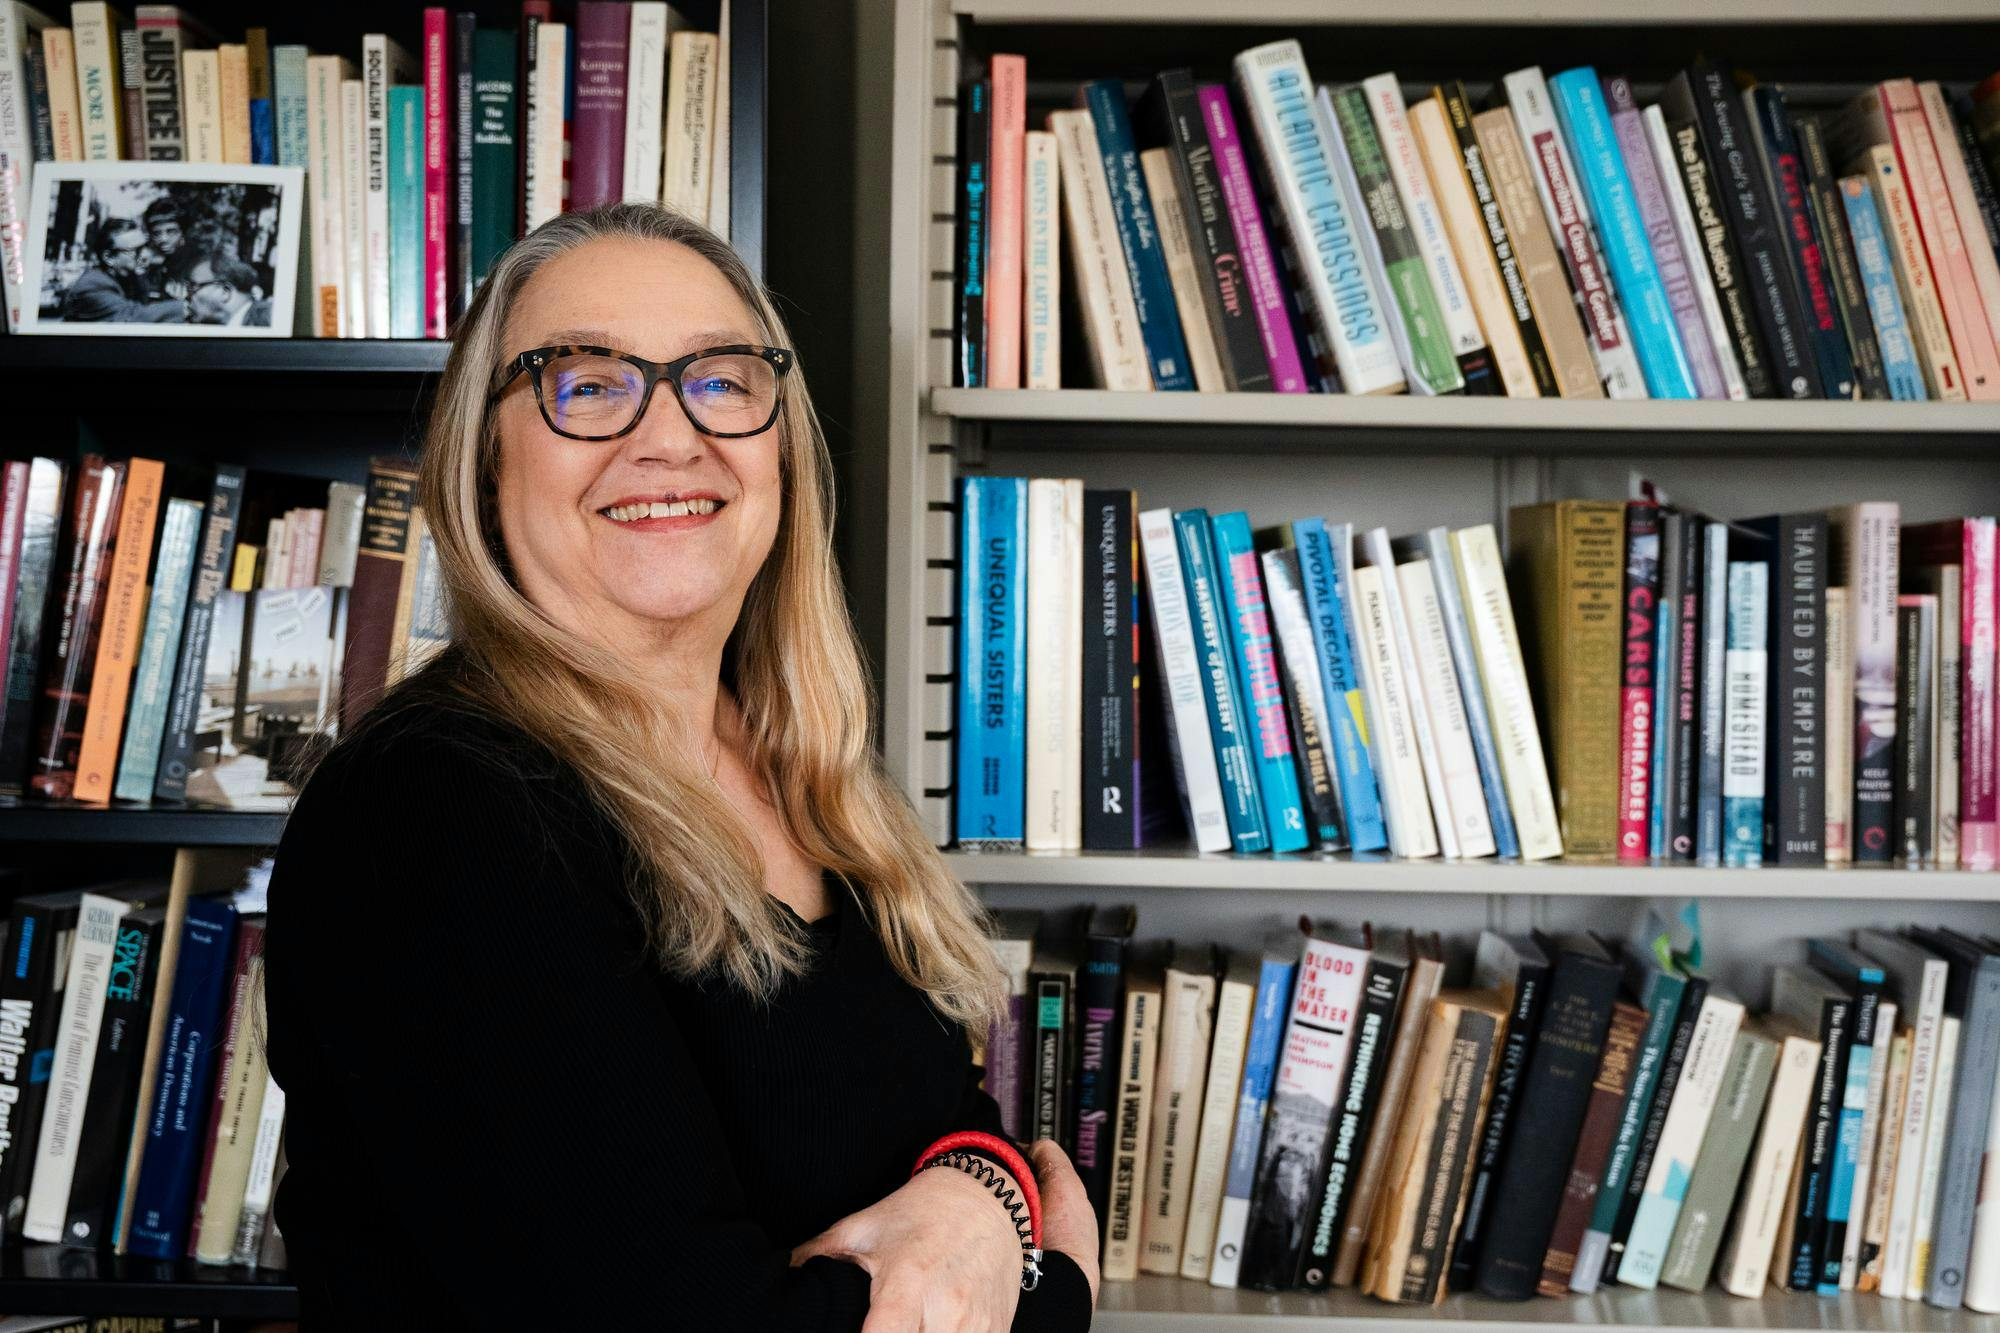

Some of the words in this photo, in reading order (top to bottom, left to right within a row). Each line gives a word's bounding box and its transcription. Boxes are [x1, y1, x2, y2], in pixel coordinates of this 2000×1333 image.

[85, 67, 102, 124] MORE
[142, 30, 181, 139] JUSTICE
[368, 49, 382, 120] SOCIALISM
[458, 72, 472, 160] SCANDINAVIANS
[369, 127, 382, 192] BETRAYED
[459, 163, 472, 172] IN
[1677, 127, 1700, 163] The
[1464, 144, 1493, 203] Separate
[1538, 140, 1575, 225] Transcribing
[1685, 160, 1709, 208] Time
[458, 175, 472, 225] CHICAGO
[1268, 69, 1333, 194] ATLANTIC
[1306, 200, 1379, 343] CROSSINGS
[1482, 201, 1506, 244] Roads
[1698, 206, 1717, 227] of
[1034, 239, 1049, 271] THE
[1495, 242, 1514, 260] to
[1567, 223, 1588, 262] Class
[1700, 226, 1733, 289] Illusion
[1033, 275, 1049, 325] EARTH
[1214, 253, 1241, 317] Crime
[1499, 257, 1532, 322] Feminism
[1582, 264, 1598, 291] and
[1588, 289, 1617, 342] Gender
[203, 514, 234, 568] Hunter
[1100, 505, 1117, 578] UNEQUAL
[195, 569, 224, 605] Elite
[987, 537, 1007, 648] UNEQUAL
[1148, 553, 1183, 633] ABORTION
[1682, 593, 1697, 619] THE
[1791, 527, 1817, 638] HAUNTED
[1102, 580, 1117, 637] SISTERS
[1194, 576, 1217, 648] HARVEST
[1304, 531, 1325, 607] PIVOTAL
[1320, 613, 1346, 693] DECADE
[1367, 590, 1388, 641] PEASANTS
[1170, 636, 1188, 674] after
[1376, 643, 1391, 664] AND
[1626, 585, 1653, 684] CARS
[1680, 621, 1696, 689] SOCIALIST
[1205, 652, 1220, 669] of
[1793, 647, 1816, 677] BY
[986, 650, 1005, 729] SISTERS
[1174, 673, 1199, 707] ROE
[1210, 668, 1233, 734] DISSENT
[1380, 664, 1400, 709] PEASANT
[1680, 691, 1695, 721] CAR
[1388, 710, 1409, 759] SOCIETIES
[1729, 670, 1756, 777] HOMESTEAD
[1791, 687, 1816, 779] EMPIRE
[1306, 748, 1330, 795] BIBLE
[1628, 700, 1650, 822] COMRADES
[84, 952, 105, 973] The
[106, 928, 143, 1003] SPACE
[1300, 968, 1317, 983] IN
[1304, 952, 1354, 976] BLOOD
[75, 973, 99, 1018] Creation
[1296, 999, 1349, 1023] WATER
[1299, 983, 1327, 1003] THE
[1831, 1004, 1847, 1026] The
[0, 999, 35, 1081] Walter
[73, 1021, 91, 1032] of
[163, 1014, 185, 1071] American
[62, 1032, 88, 1080] Feminist
[176, 1031, 201, 1107] Corporations
[1041, 1038, 1055, 1087] WOMEN
[1344, 1012, 1382, 1112] RETHINKING
[1819, 1027, 1844, 1102] Incorporation
[1911, 1024, 1935, 1095] FACTORY
[153, 1072, 177, 1137] Democracy
[1041, 1092, 1055, 1120] AND
[1125, 1083, 1142, 1093] A
[1170, 1091, 1182, 1107] The
[1625, 1099, 1642, 1125] and
[1818, 1103, 1833, 1119] of
[49, 1081, 80, 1158] Consciousness
[174, 1108, 186, 1131] and
[1078, 1108, 1108, 1169] STREET
[1120, 1097, 1141, 1151] WORLD
[1164, 1111, 1180, 1146] Closing
[1334, 1113, 1360, 1162] HOME
[1619, 1124, 1636, 1144] the
[1811, 1119, 1831, 1165] America
[1906, 1098, 1925, 1145] GIRLS
[1112, 1156, 1137, 1241] DESTROYED
[1163, 1161, 1175, 1190] Baker
[1158, 1192, 1172, 1216] Plant
[1312, 1162, 1348, 1257] ECONOMICS
[1421, 1216, 1443, 1250] CLASS
